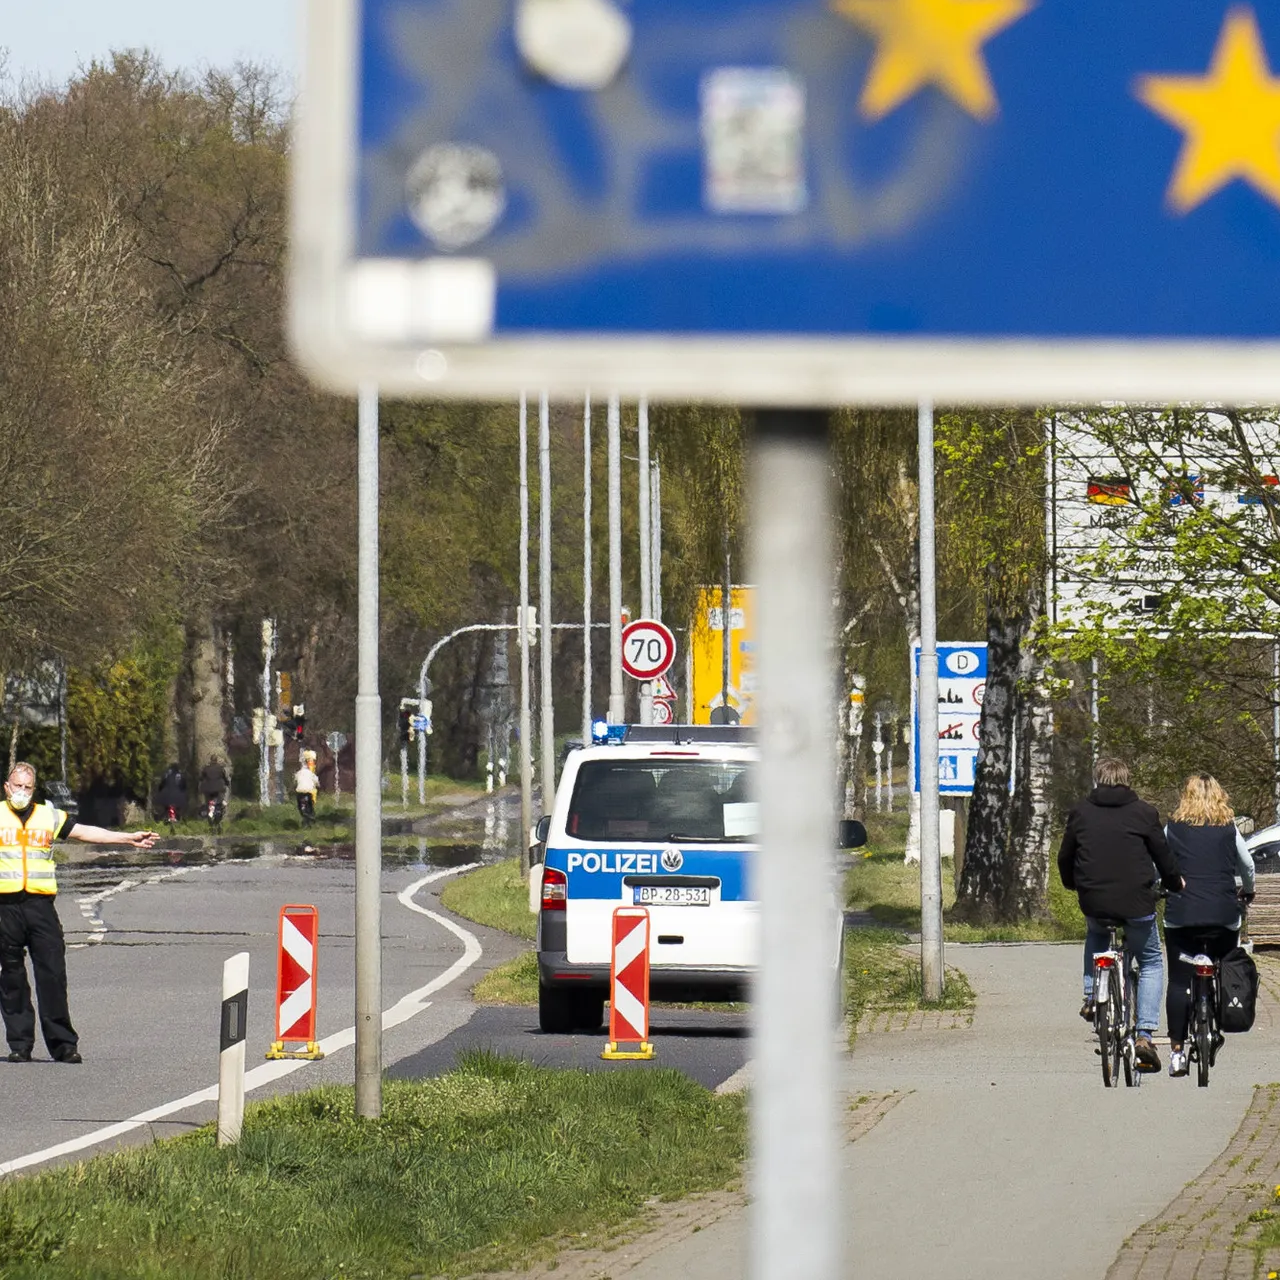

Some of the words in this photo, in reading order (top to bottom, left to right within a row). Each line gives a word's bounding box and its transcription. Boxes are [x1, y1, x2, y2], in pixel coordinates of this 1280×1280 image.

[631, 639, 661, 662] 70
[957, 655, 968, 669] D
[567, 853, 657, 873] POLIZEI
